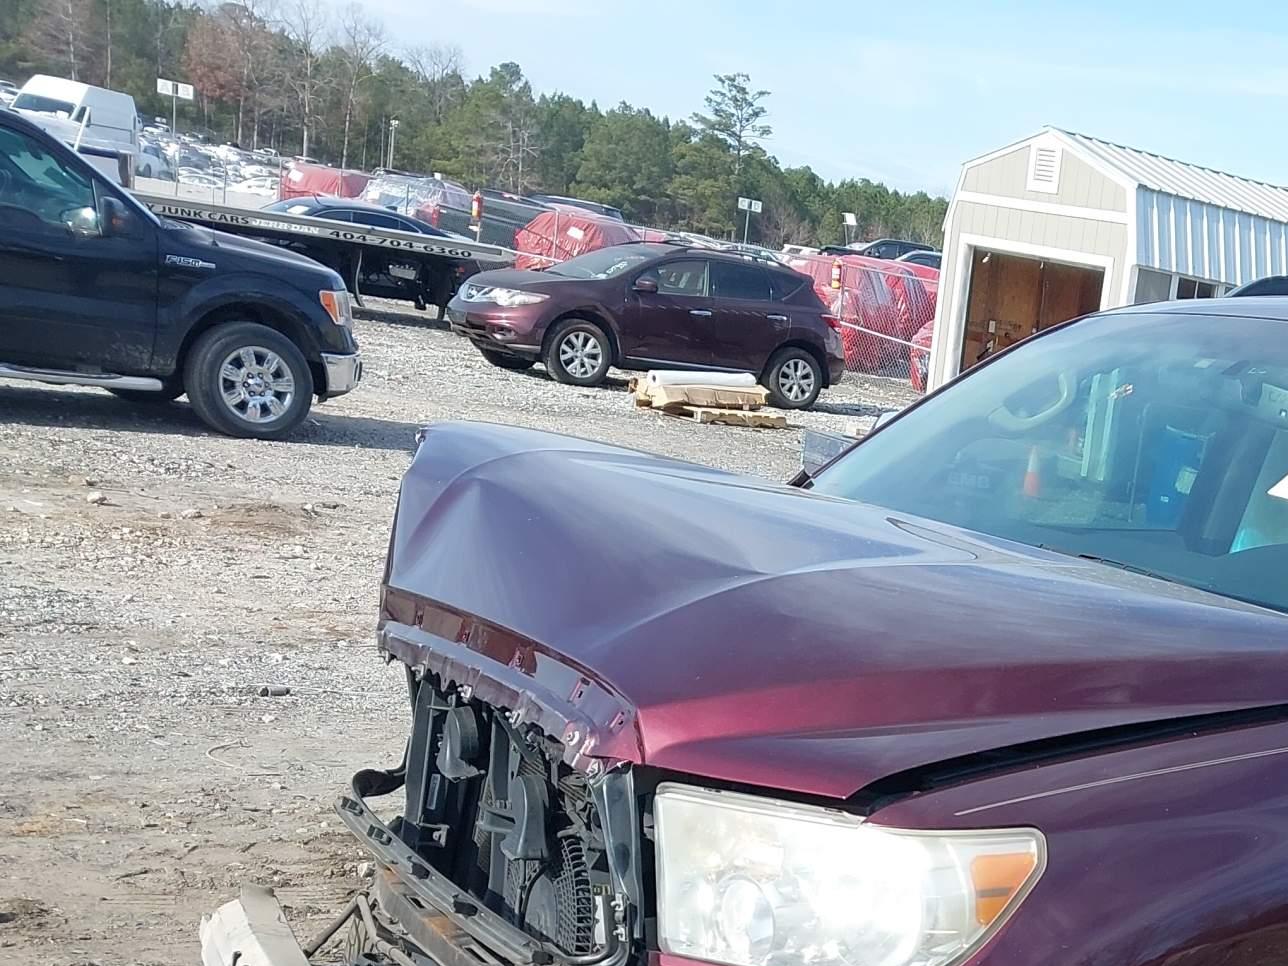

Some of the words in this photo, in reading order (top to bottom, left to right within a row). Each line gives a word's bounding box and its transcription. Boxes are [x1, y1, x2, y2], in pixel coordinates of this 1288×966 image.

[161, 205, 203, 218] JUNK
[208, 212, 249, 225] CARS
[329, 230, 473, 258] 404-704-6360
